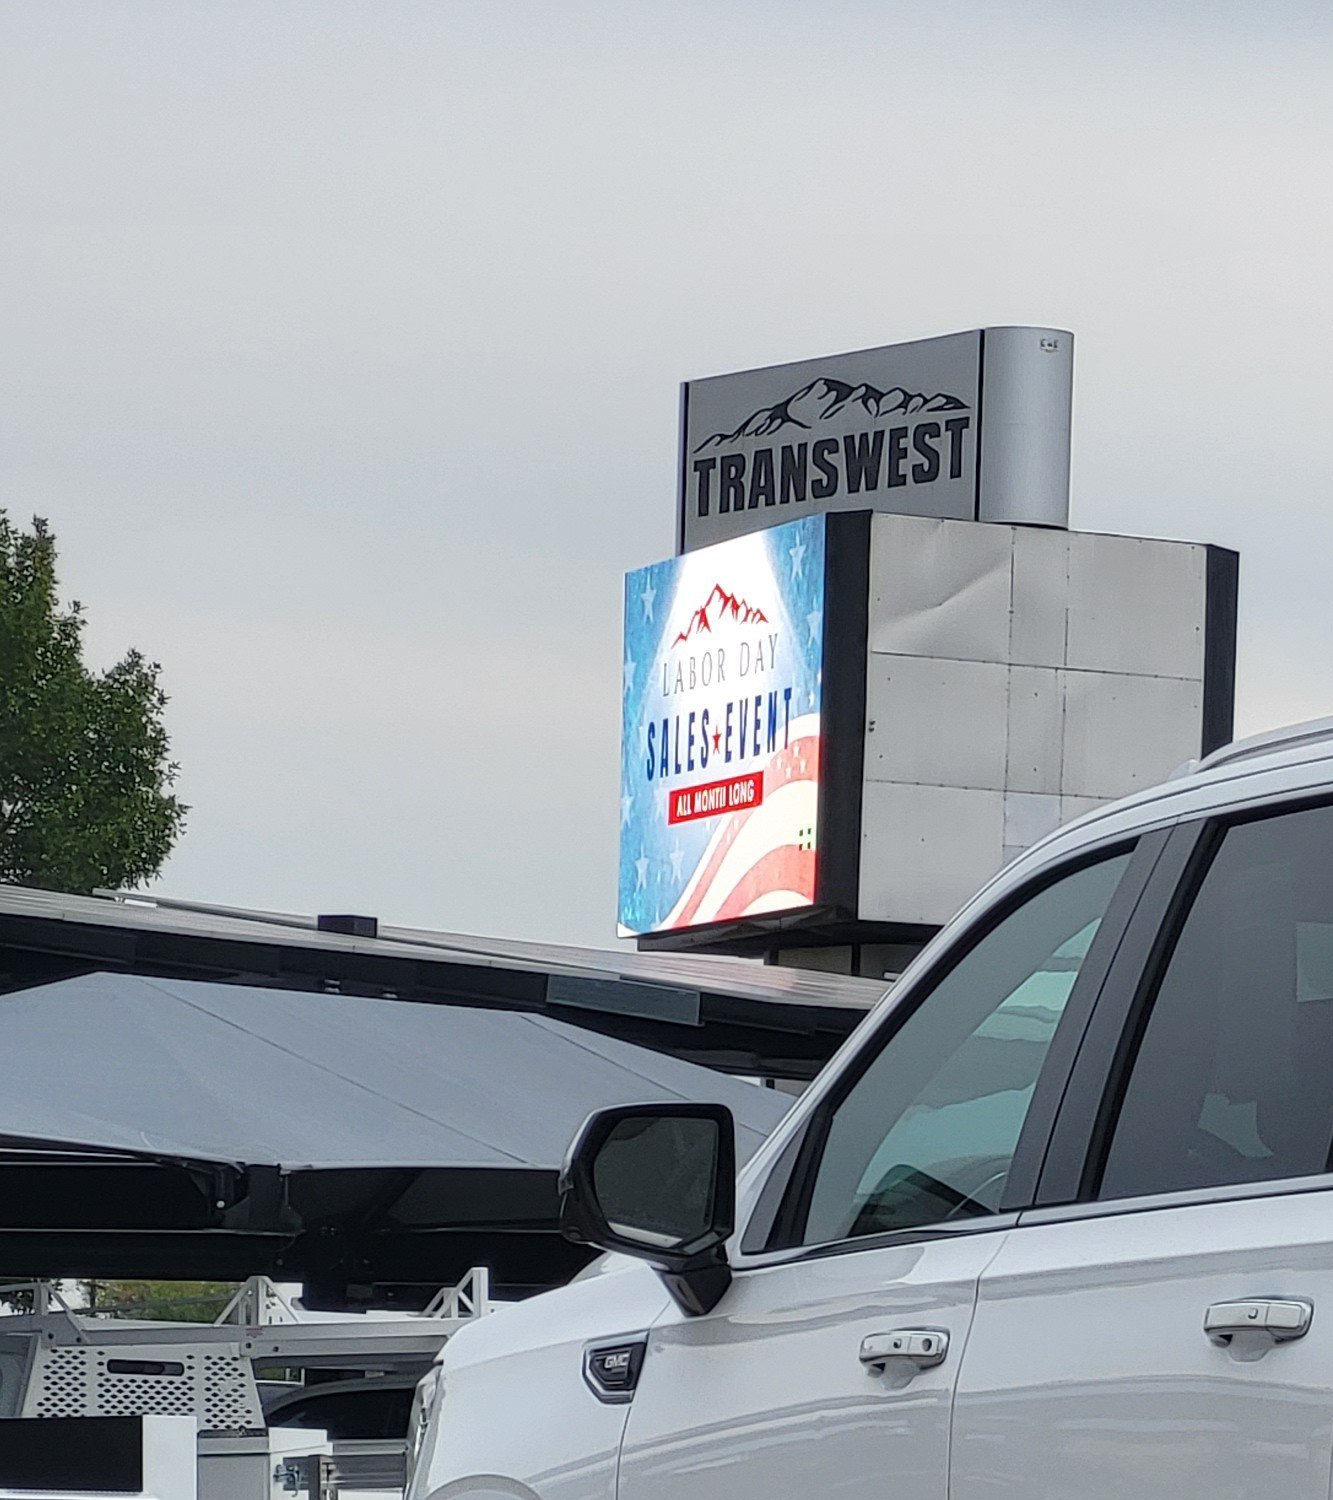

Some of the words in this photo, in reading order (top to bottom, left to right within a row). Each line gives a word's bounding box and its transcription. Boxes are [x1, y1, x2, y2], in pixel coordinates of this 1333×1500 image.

[693, 416, 970, 517] TRANSWEST
[663, 648, 726, 697] LABOR
[739, 633, 778, 677] DAY
[646, 708, 710, 781] SALES
[725, 687, 792, 763] EVENT
[676, 790, 692, 817] ALL
[694, 784, 727, 812] MONTH
[728, 779, 755, 806] LONG
[604, 1353, 630, 1368] GMC
